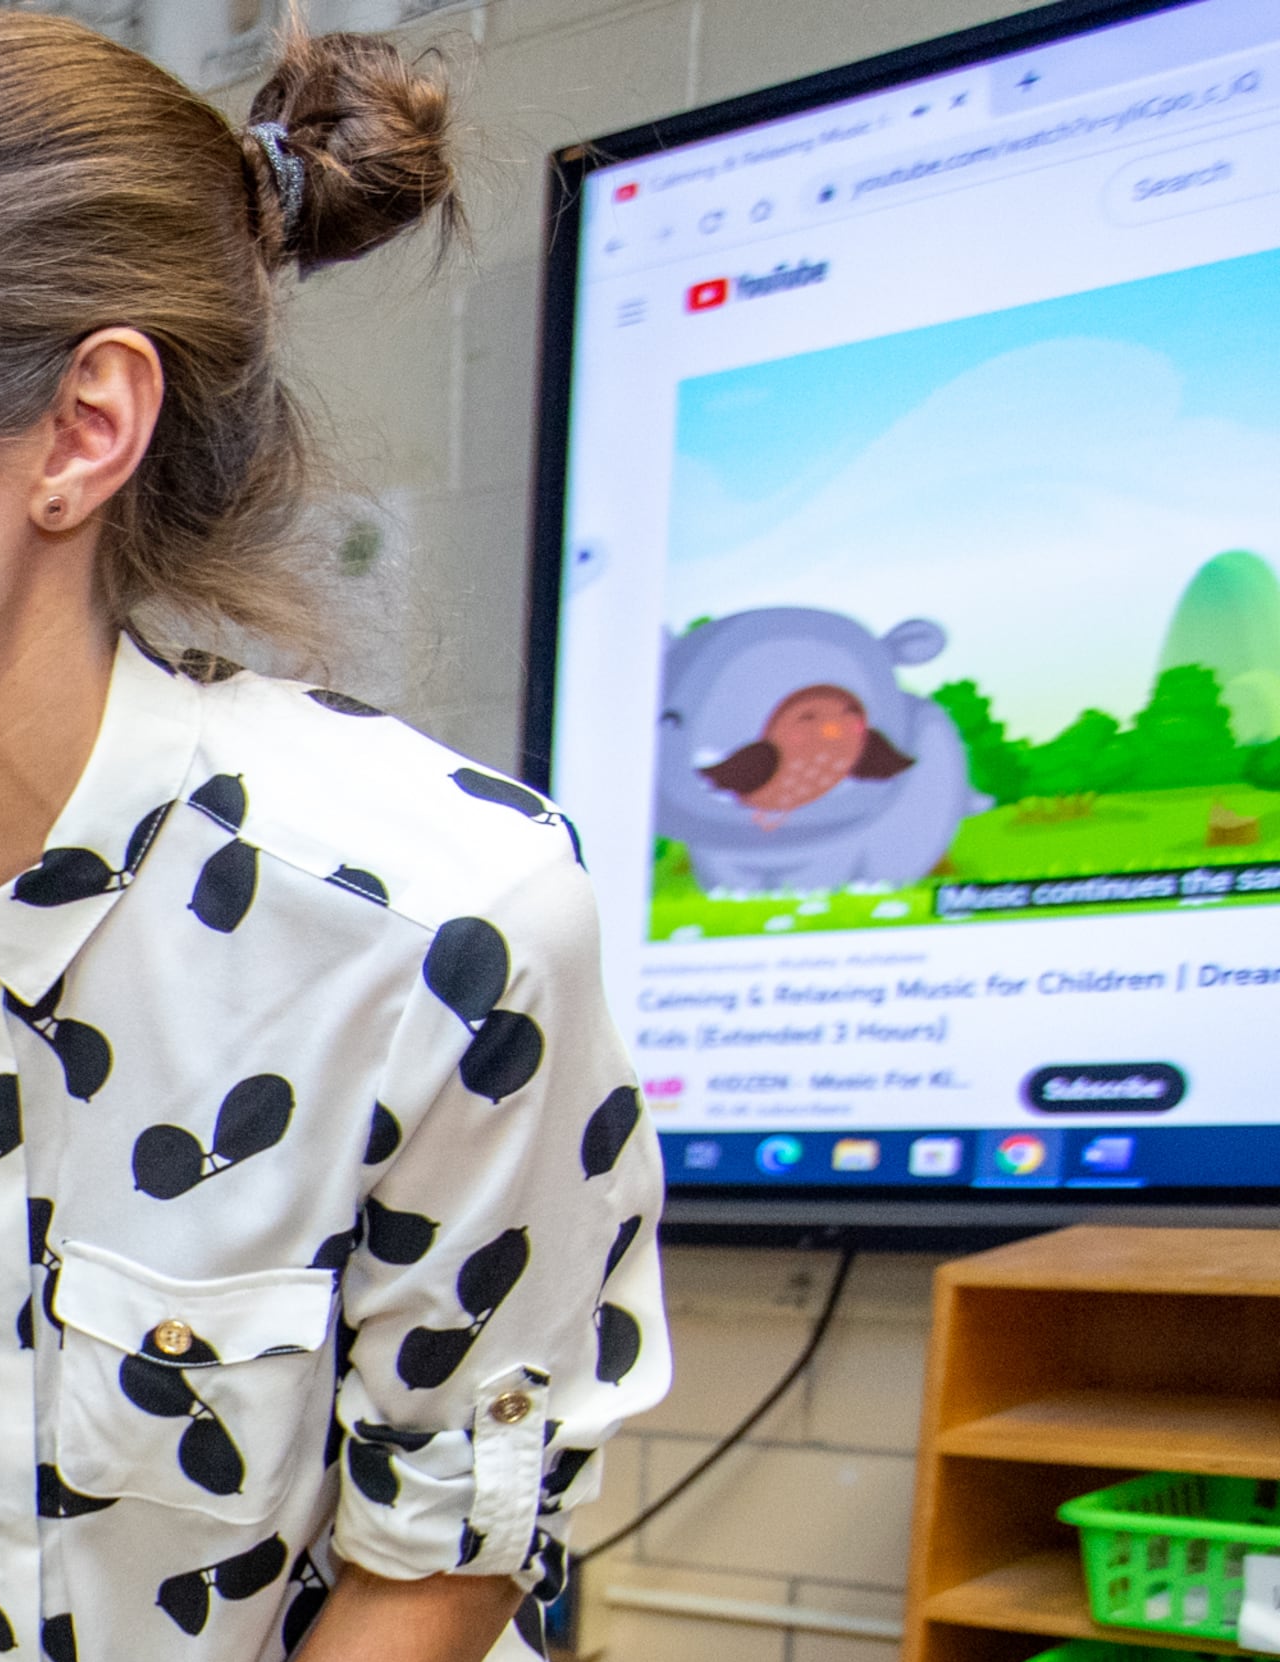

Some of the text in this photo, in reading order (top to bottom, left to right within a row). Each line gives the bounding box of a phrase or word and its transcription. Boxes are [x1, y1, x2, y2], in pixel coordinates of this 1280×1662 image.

[1133, 160, 1232, 201] Search
[737, 258, 830, 300] YouTube
[937, 883, 1029, 916] Music
[1032, 874, 1177, 906] continues
[1179, 868, 1235, 896] the
[637, 986, 737, 1012] Calming
[773, 981, 885, 1006] Relaxing
[897, 978, 976, 1000] Music
[986, 974, 1025, 995] for
[1037, 967, 1164, 994] Children
[637, 1030, 687, 1046] Kids
[831, 1020, 849, 1043] 3
[1043, 1074, 1167, 1100] Subscribe
